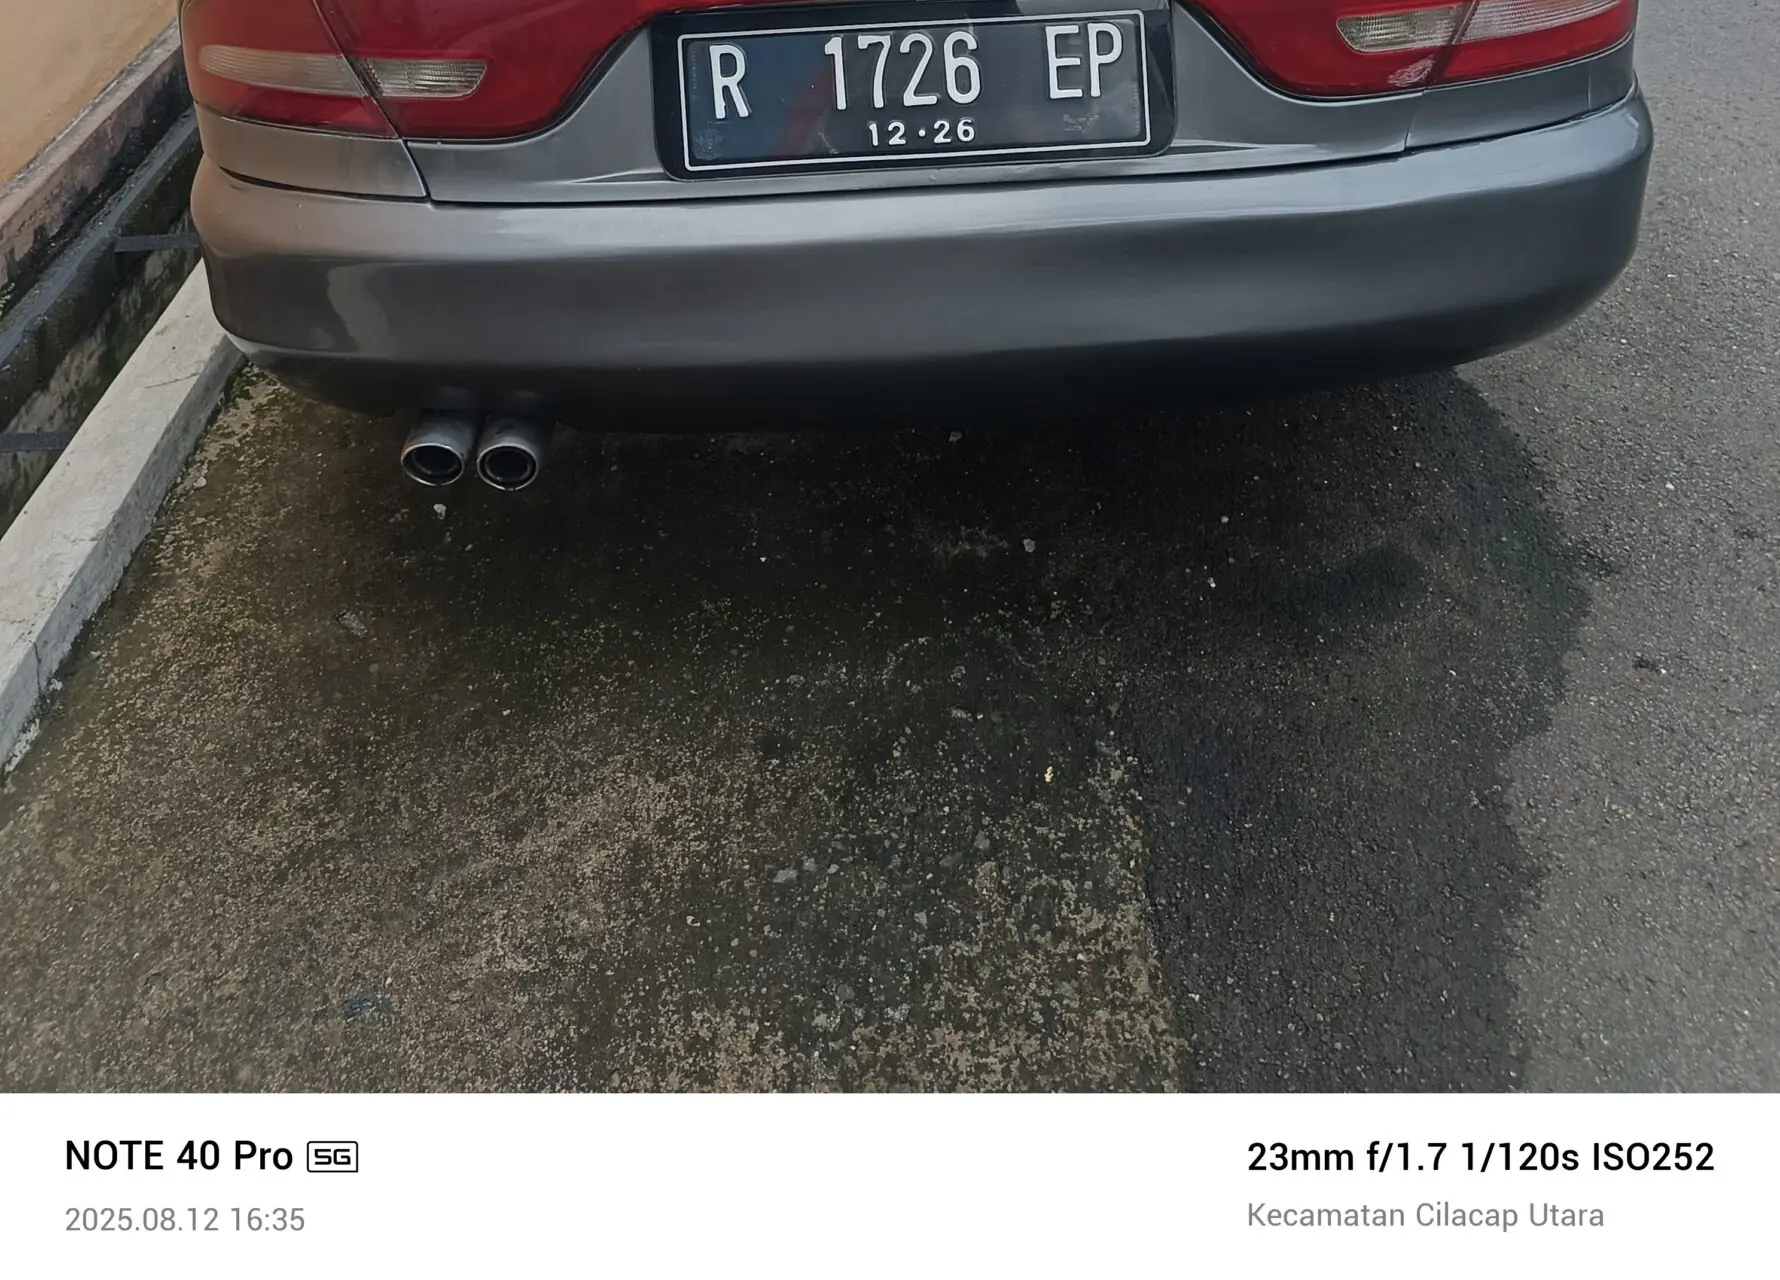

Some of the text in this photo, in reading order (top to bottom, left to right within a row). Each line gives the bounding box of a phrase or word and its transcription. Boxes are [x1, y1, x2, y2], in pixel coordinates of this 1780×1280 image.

[709, 44, 750, 120] R
[824, 30, 981, 110] 1726
[1045, 22, 1122, 99] EP
